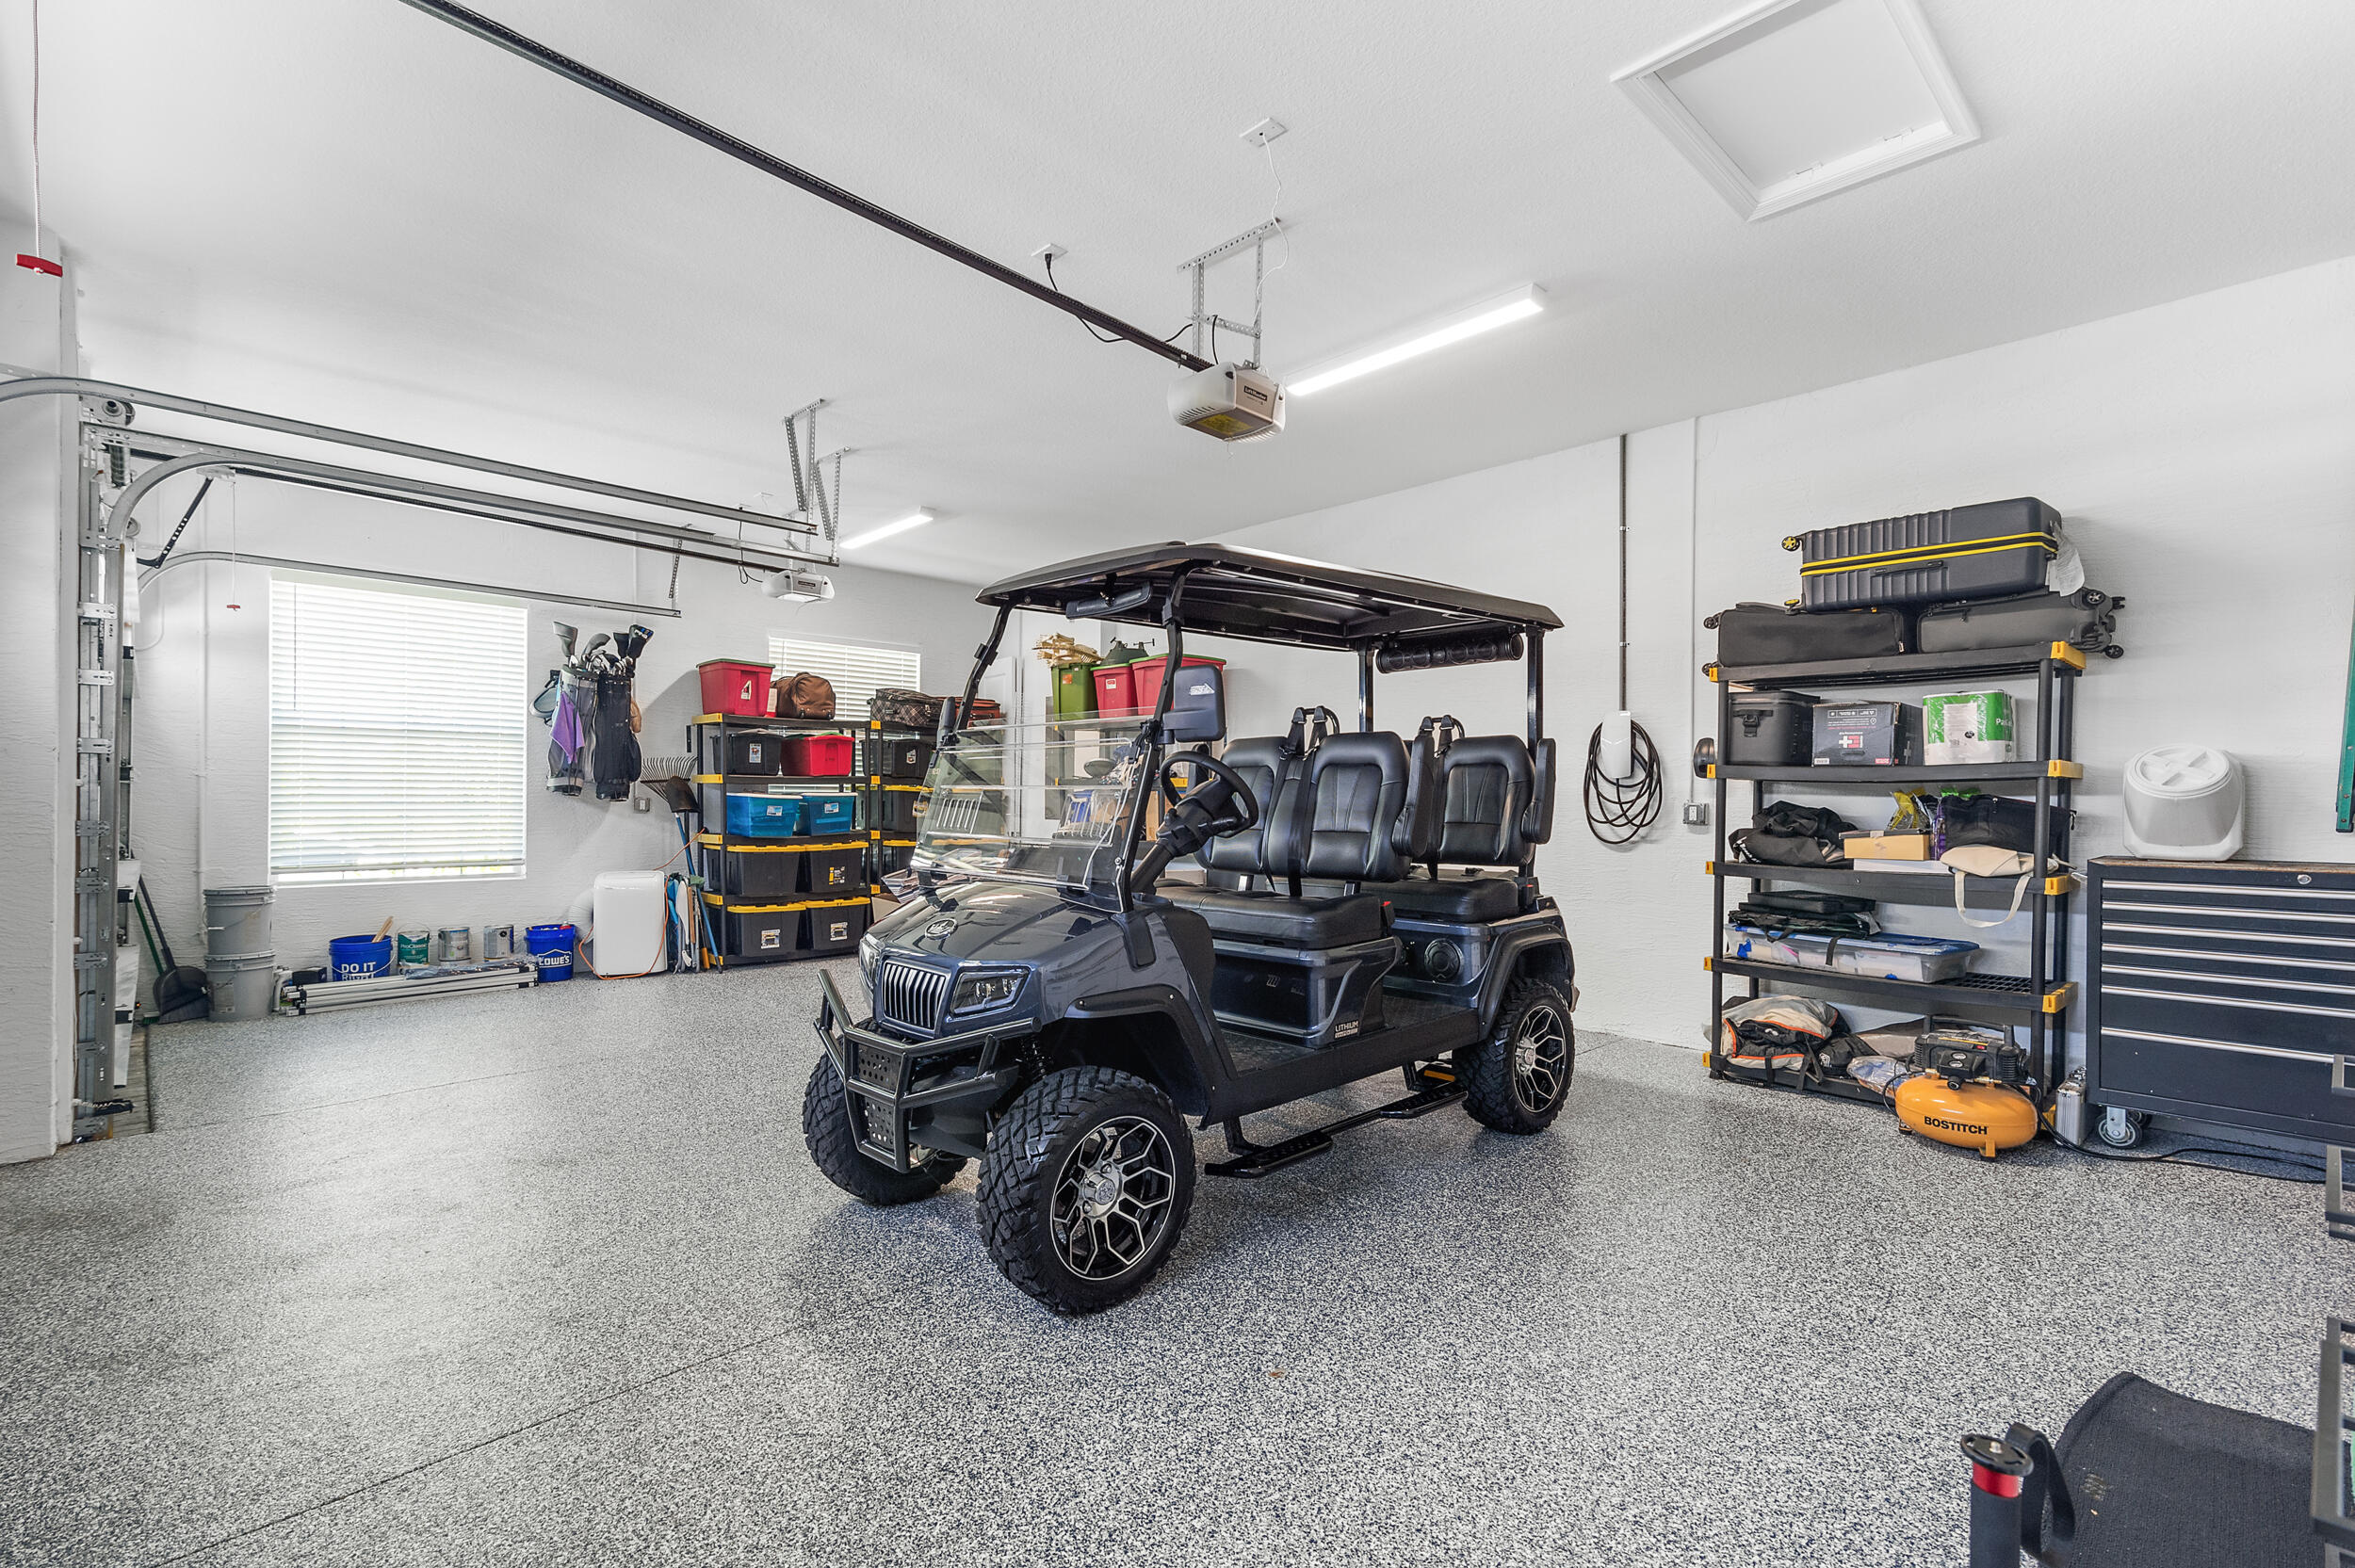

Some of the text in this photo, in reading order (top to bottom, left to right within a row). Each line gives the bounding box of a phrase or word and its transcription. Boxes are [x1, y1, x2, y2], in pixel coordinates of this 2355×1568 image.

[539, 955, 570, 966] LOWE'S
[341, 962, 377, 973] DO IT
[1335, 1020, 1359, 1032] LITHIUM
[1924, 1115, 1988, 1136] BOSTITCH
